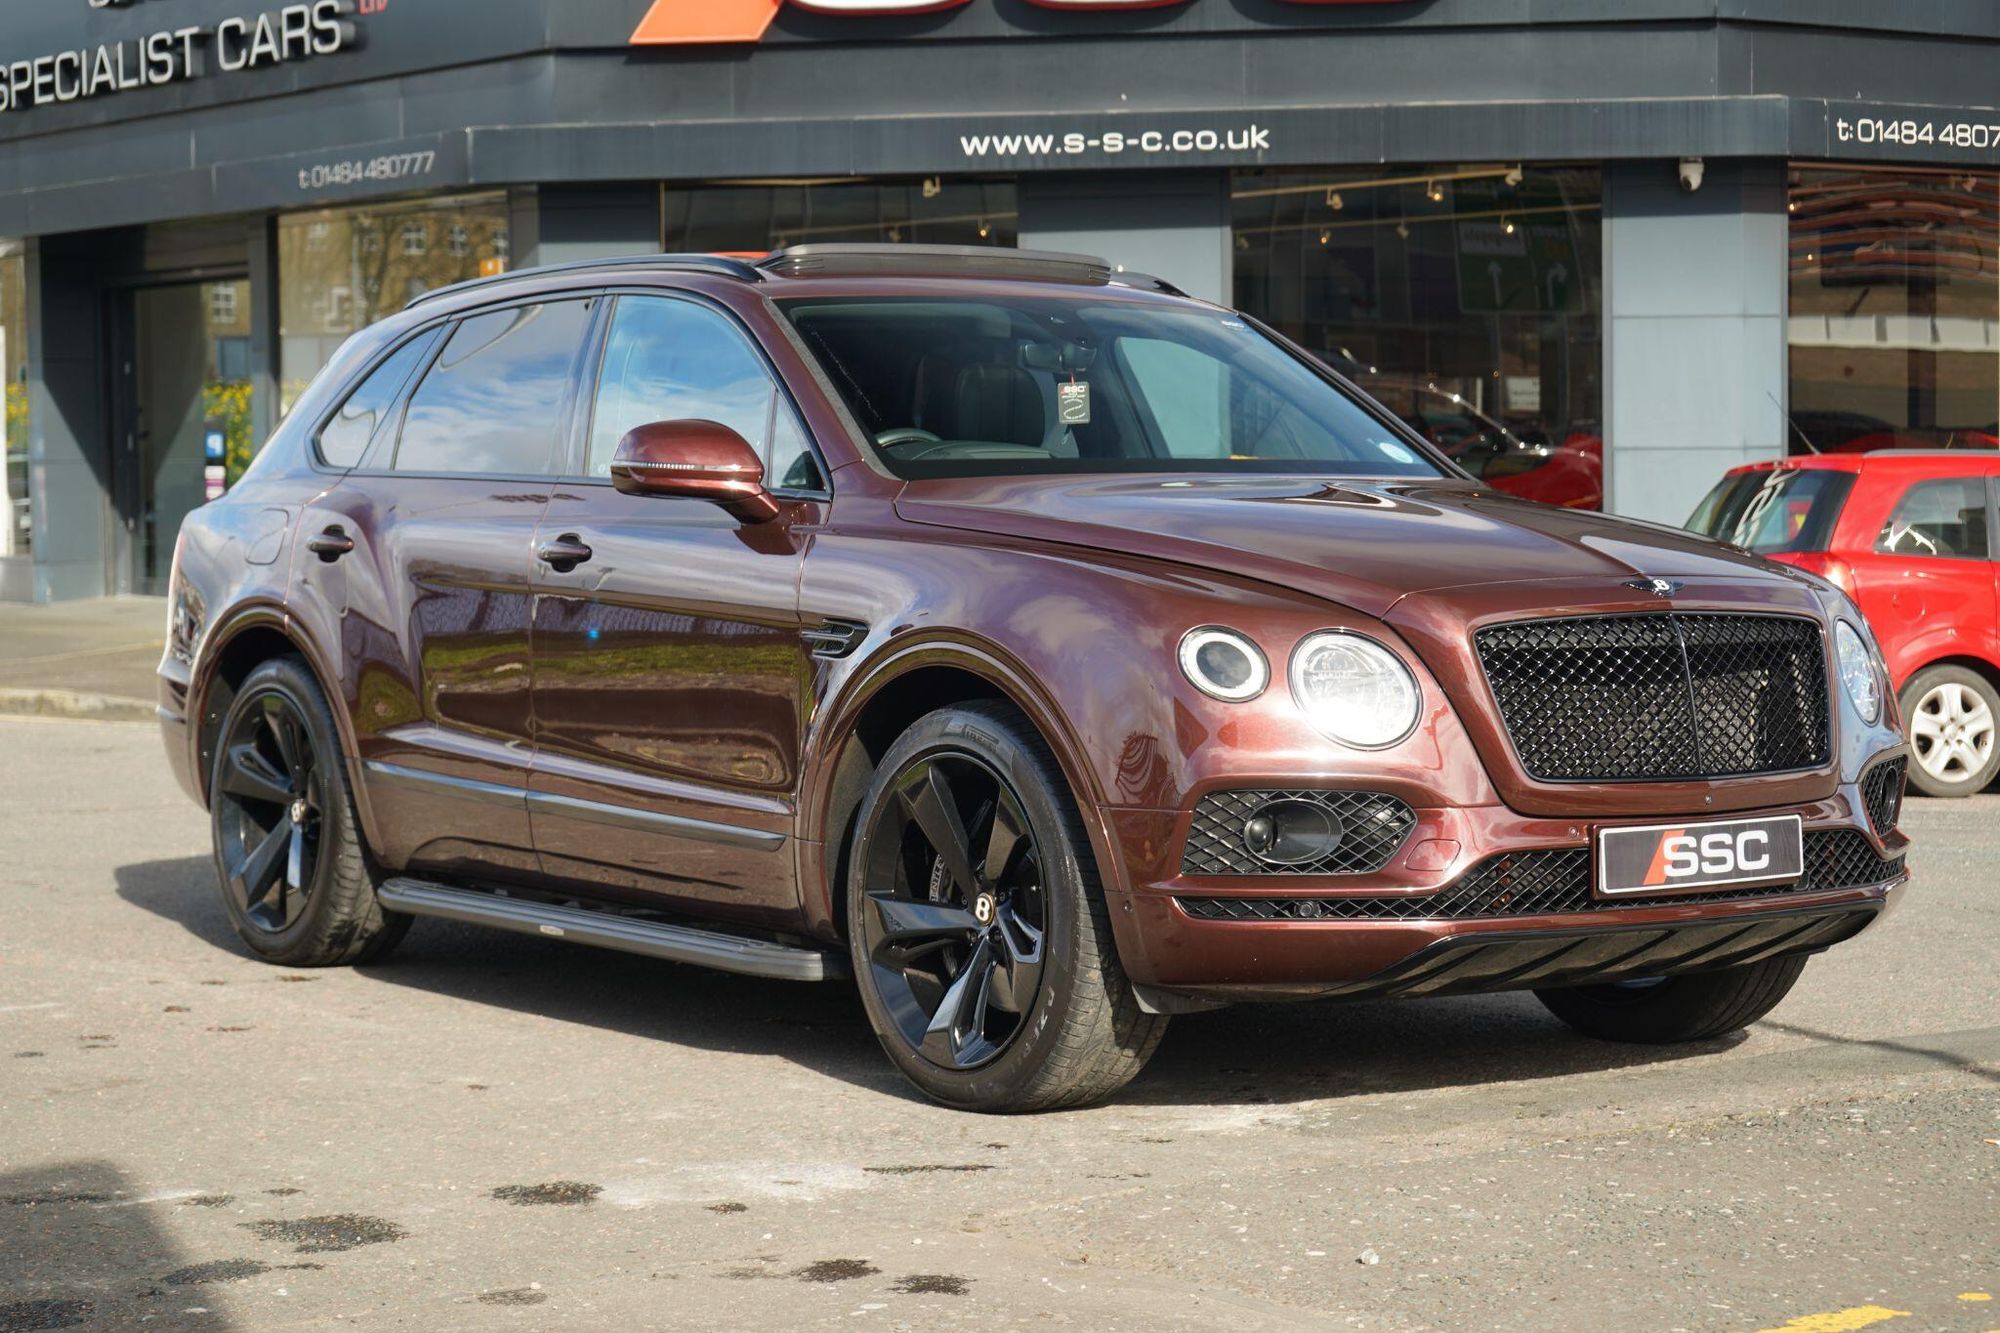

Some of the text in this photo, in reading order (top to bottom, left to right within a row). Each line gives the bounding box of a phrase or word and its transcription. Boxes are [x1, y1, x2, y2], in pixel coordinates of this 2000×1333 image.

[217, 0, 342, 71] CARS
[960, 124, 1270, 156] www.s-s-c.co.uk
[364, 150, 436, 180] 480777
[1663, 829, 1770, 877] SSC
